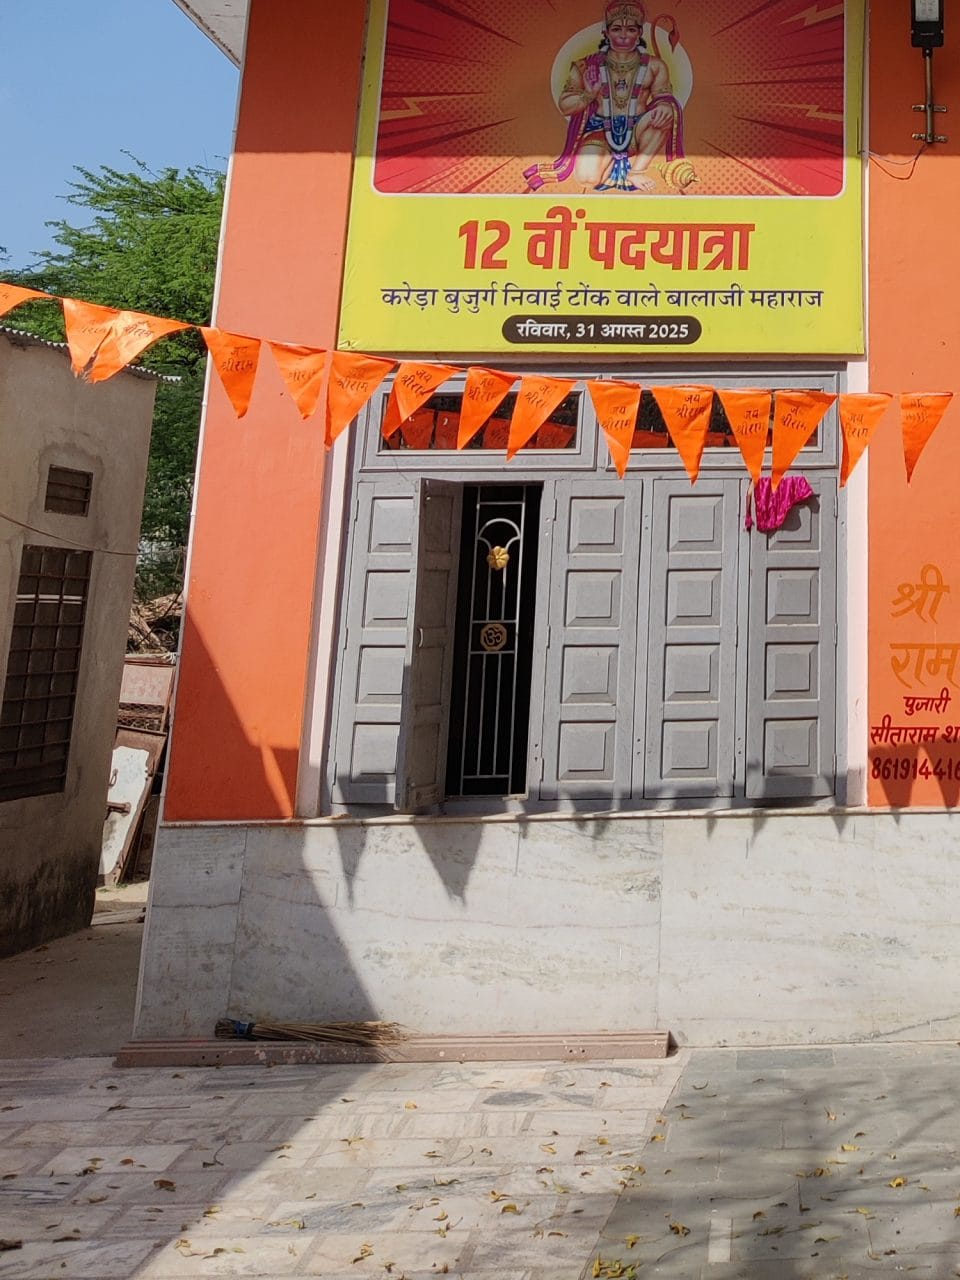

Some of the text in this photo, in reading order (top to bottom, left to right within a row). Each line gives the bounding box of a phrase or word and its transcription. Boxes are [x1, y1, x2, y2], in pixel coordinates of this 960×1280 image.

[458, 220, 511, 269] 12
[585, 222, 756, 270] पदयात्रा
[381, 281, 824, 313] करेड़ा बुजुर्ग निवाई टोंक वाले बालाजी महाराज
[516, 320, 689, 340] रविवार, 31 अगस्त 2025
[903, 687, 952, 716] पुजारी
[871, 714, 939, 747] सीताराम
